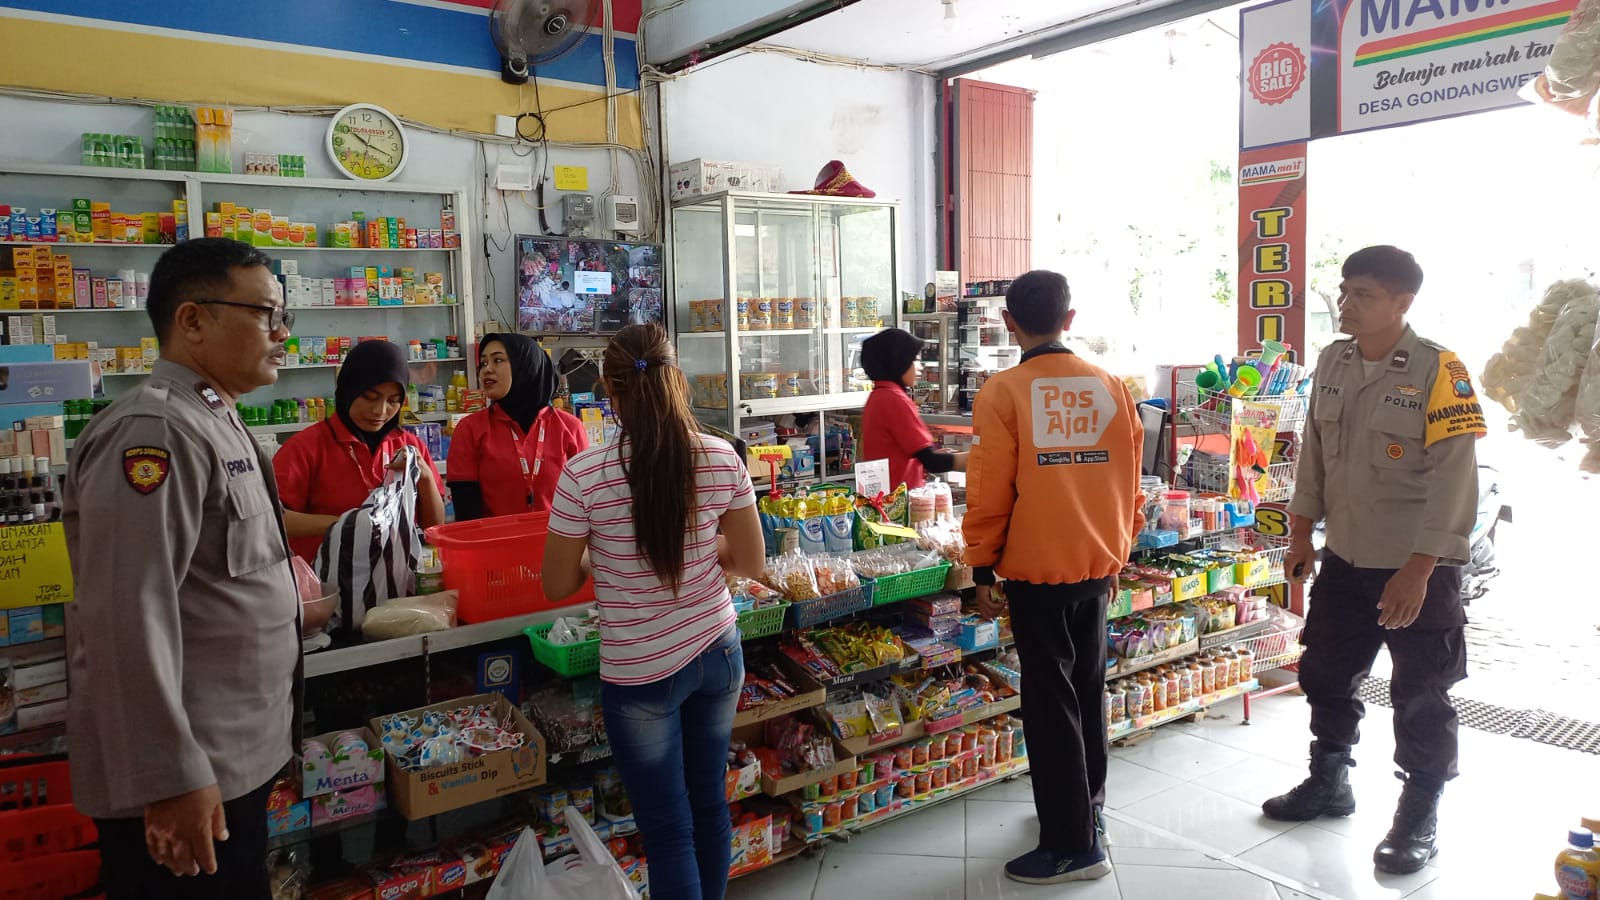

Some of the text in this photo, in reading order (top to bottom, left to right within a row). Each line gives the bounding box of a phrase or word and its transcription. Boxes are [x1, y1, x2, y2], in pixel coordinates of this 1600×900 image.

[1360, 0, 1510, 37] MA
[1260, 53, 1293, 80] BIG
[1373, 62, 1447, 90] Belanja
[1450, 45, 1522, 75] murah
[1260, 75, 1293, 93] SALE
[1358, 97, 1403, 115] DESA
[348, 116, 356, 126] 11
[361, 112, 372, 122] 12
[340, 124, 350, 135] 10
[379, 120, 383, 129] 1
[387, 129, 395, 139] 2
[334, 136, 343, 147] 9
[391, 142, 398, 152] 3
[340, 151, 347, 161] 8
[387, 155, 394, 165] 4
[350, 162, 357, 171] 7
[363, 166, 371, 176] 6
[376, 163, 385, 173] 5
[1242, 160, 1303, 178] MAMA mart
[1249, 206, 1297, 363] TERI
[1038, 385, 1094, 409] Pos
[1384, 395, 1423, 411] POLRI
[1045, 409, 1099, 440] Aja!
[0, 538, 46, 551] ELANJA
[420, 760, 485, 783] Biscuits Stick
[315, 771, 370, 791] Menta
[427, 782, 439, 796] &
[480, 768, 499, 781] Dip
